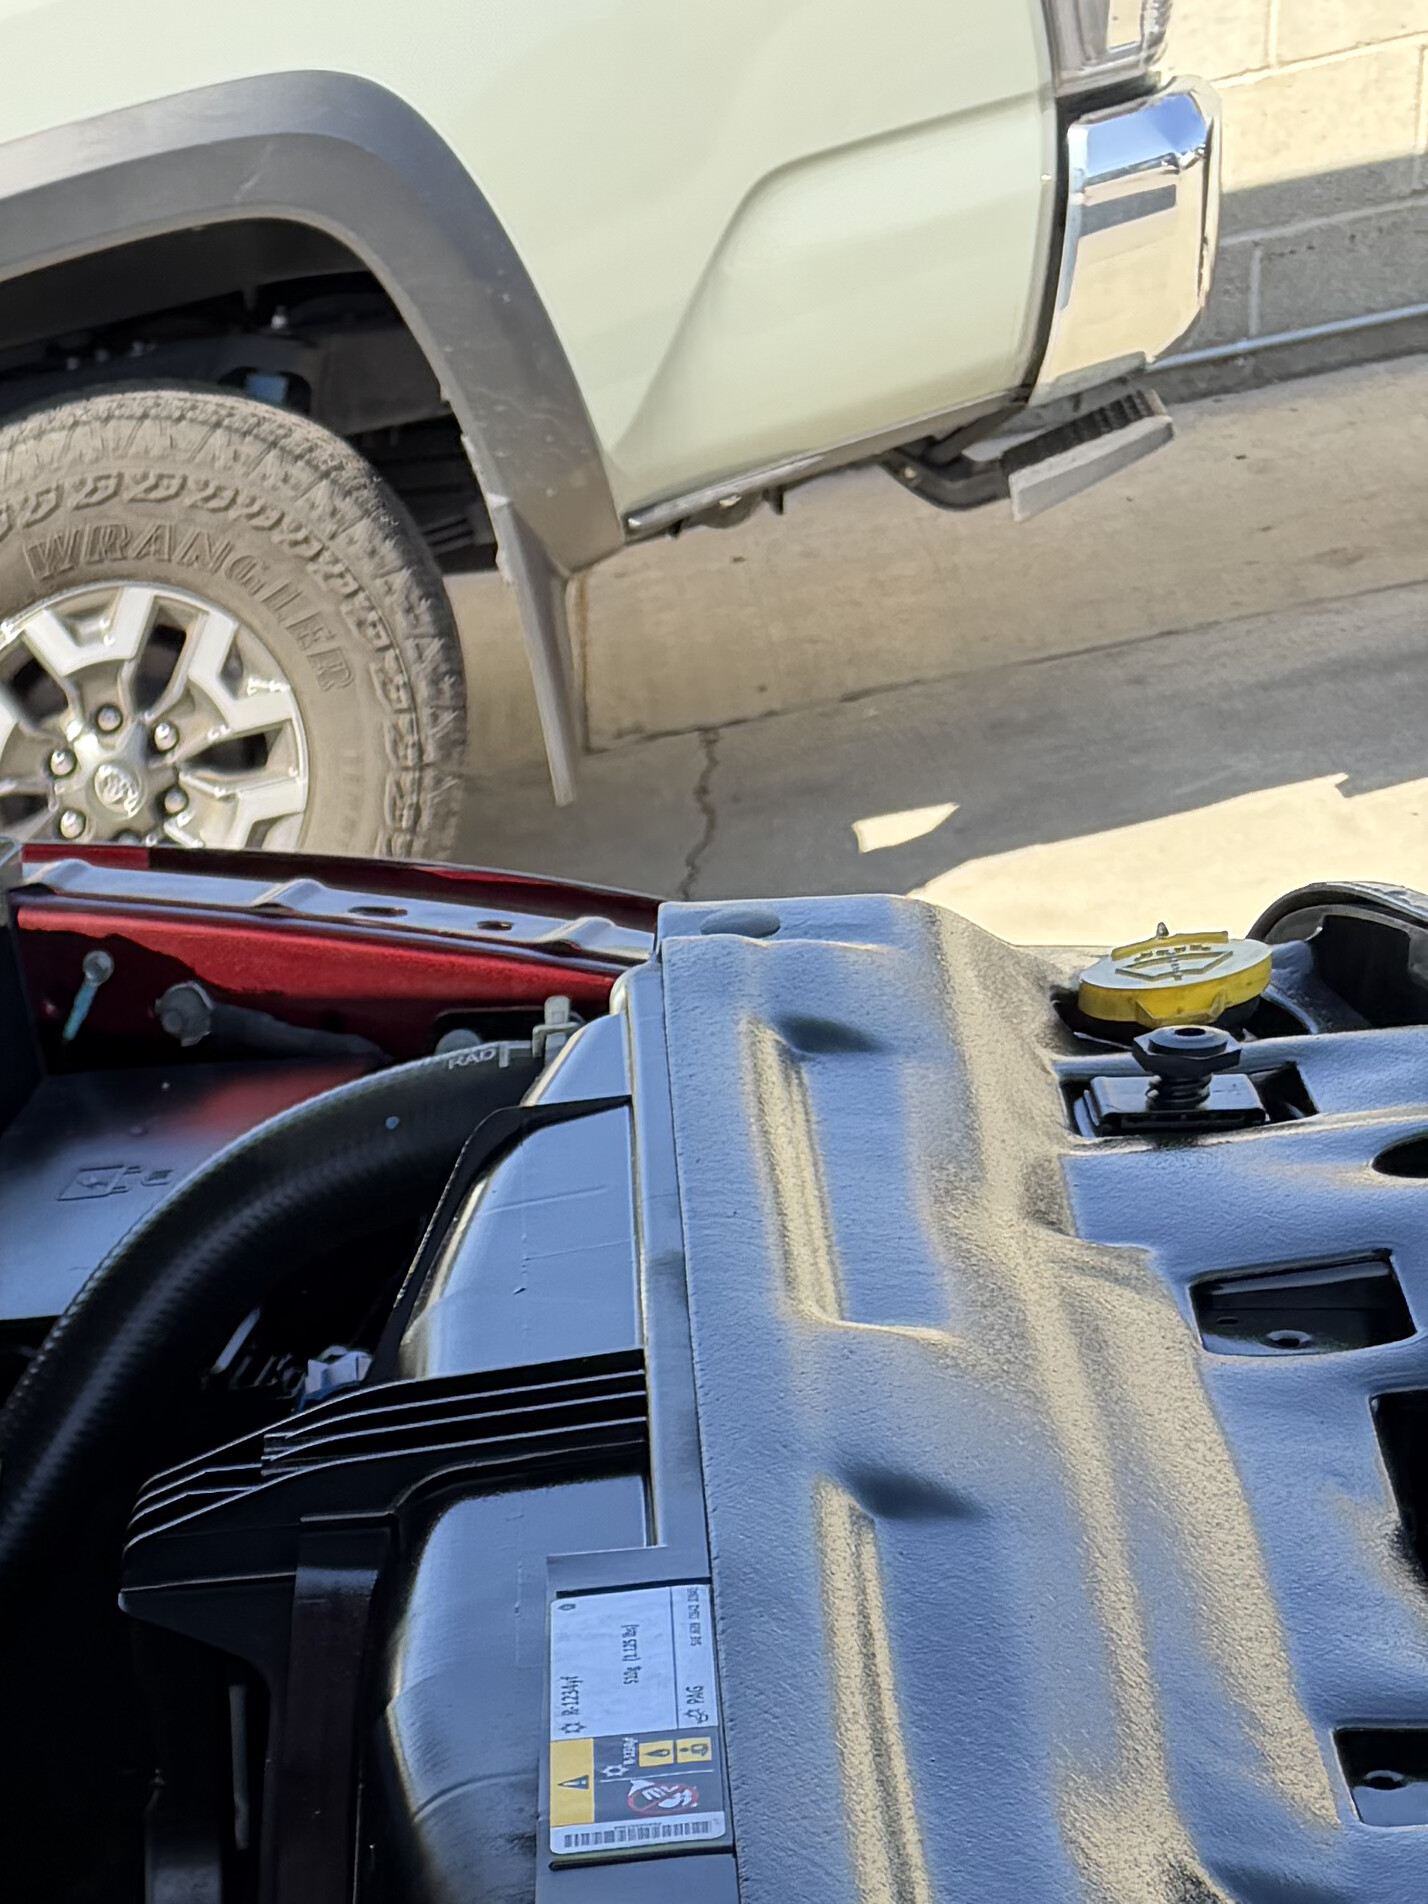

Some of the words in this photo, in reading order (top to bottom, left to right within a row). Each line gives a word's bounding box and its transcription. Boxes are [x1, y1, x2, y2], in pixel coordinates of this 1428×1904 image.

[24, 523, 356, 692] WRANGLER
[560, 1675, 584, 1717] R-1234yf
[685, 1685, 705, 1704] PAG
